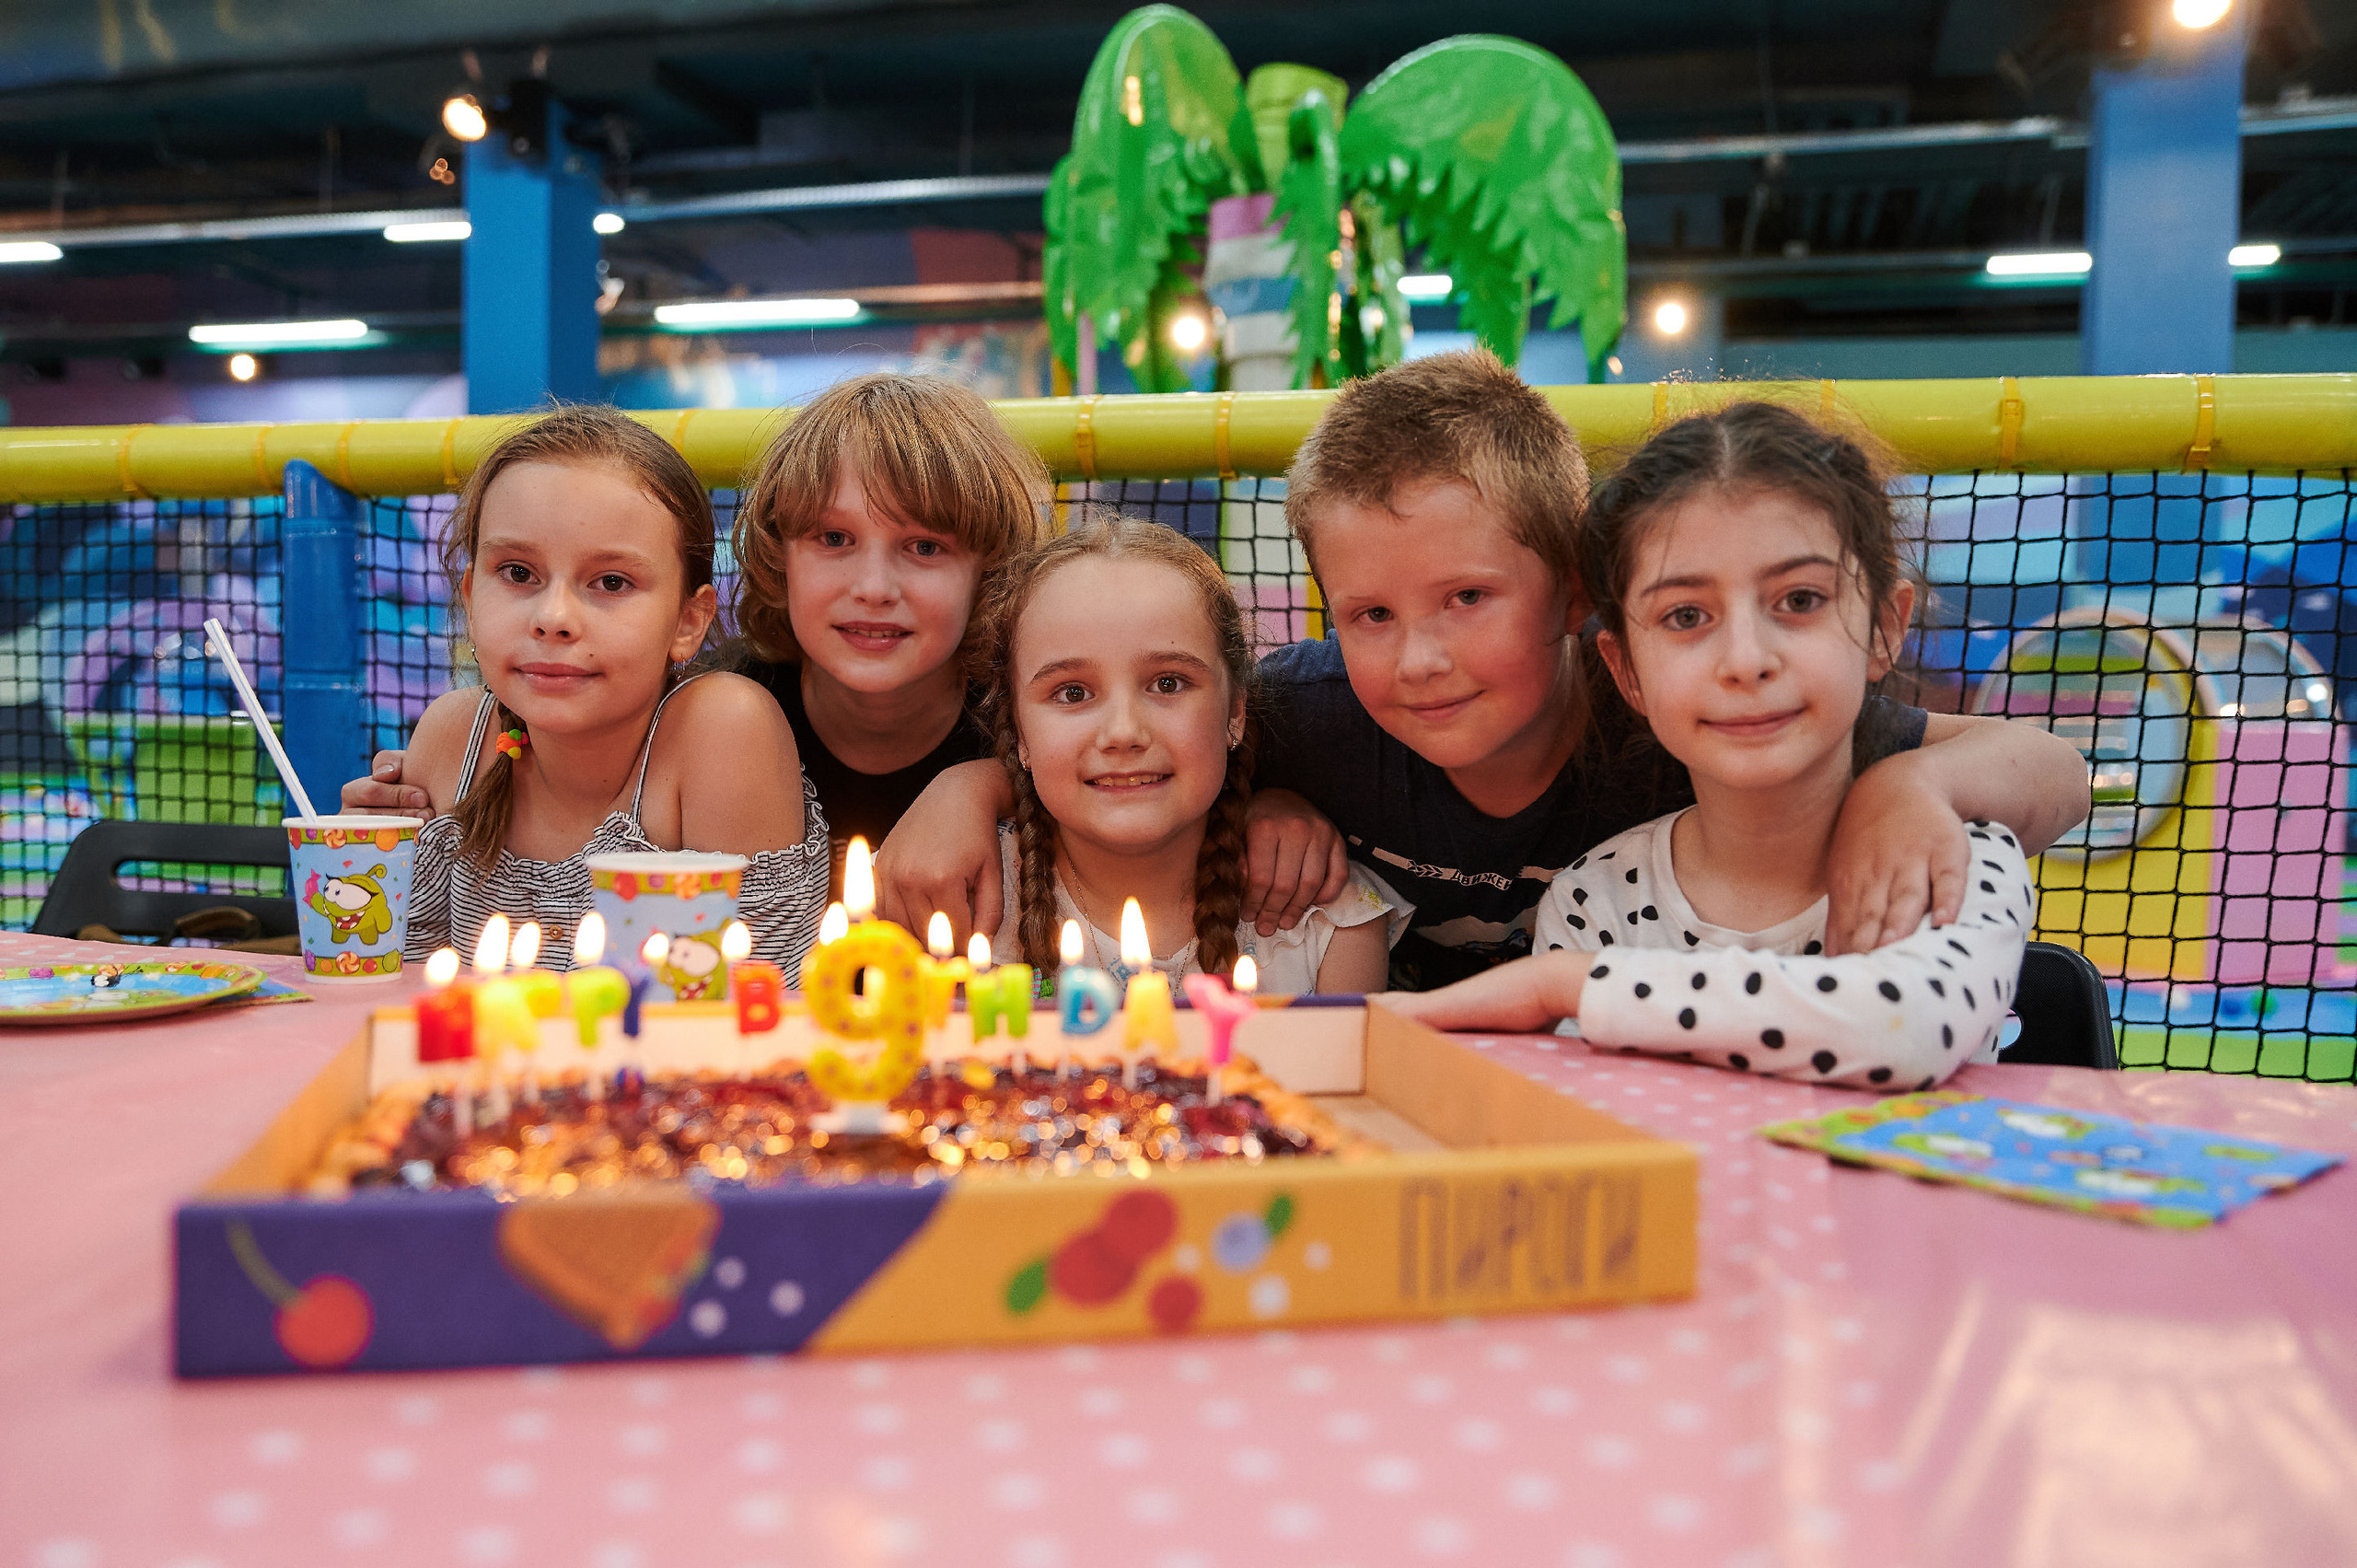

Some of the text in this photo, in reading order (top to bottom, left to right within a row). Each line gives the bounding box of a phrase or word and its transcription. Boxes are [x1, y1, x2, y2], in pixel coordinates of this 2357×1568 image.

[734, 958, 1258, 1063] BTHDAY
[808, 921, 923, 1101] 9
[1398, 1170, 1643, 1299] ПИРОГИ
